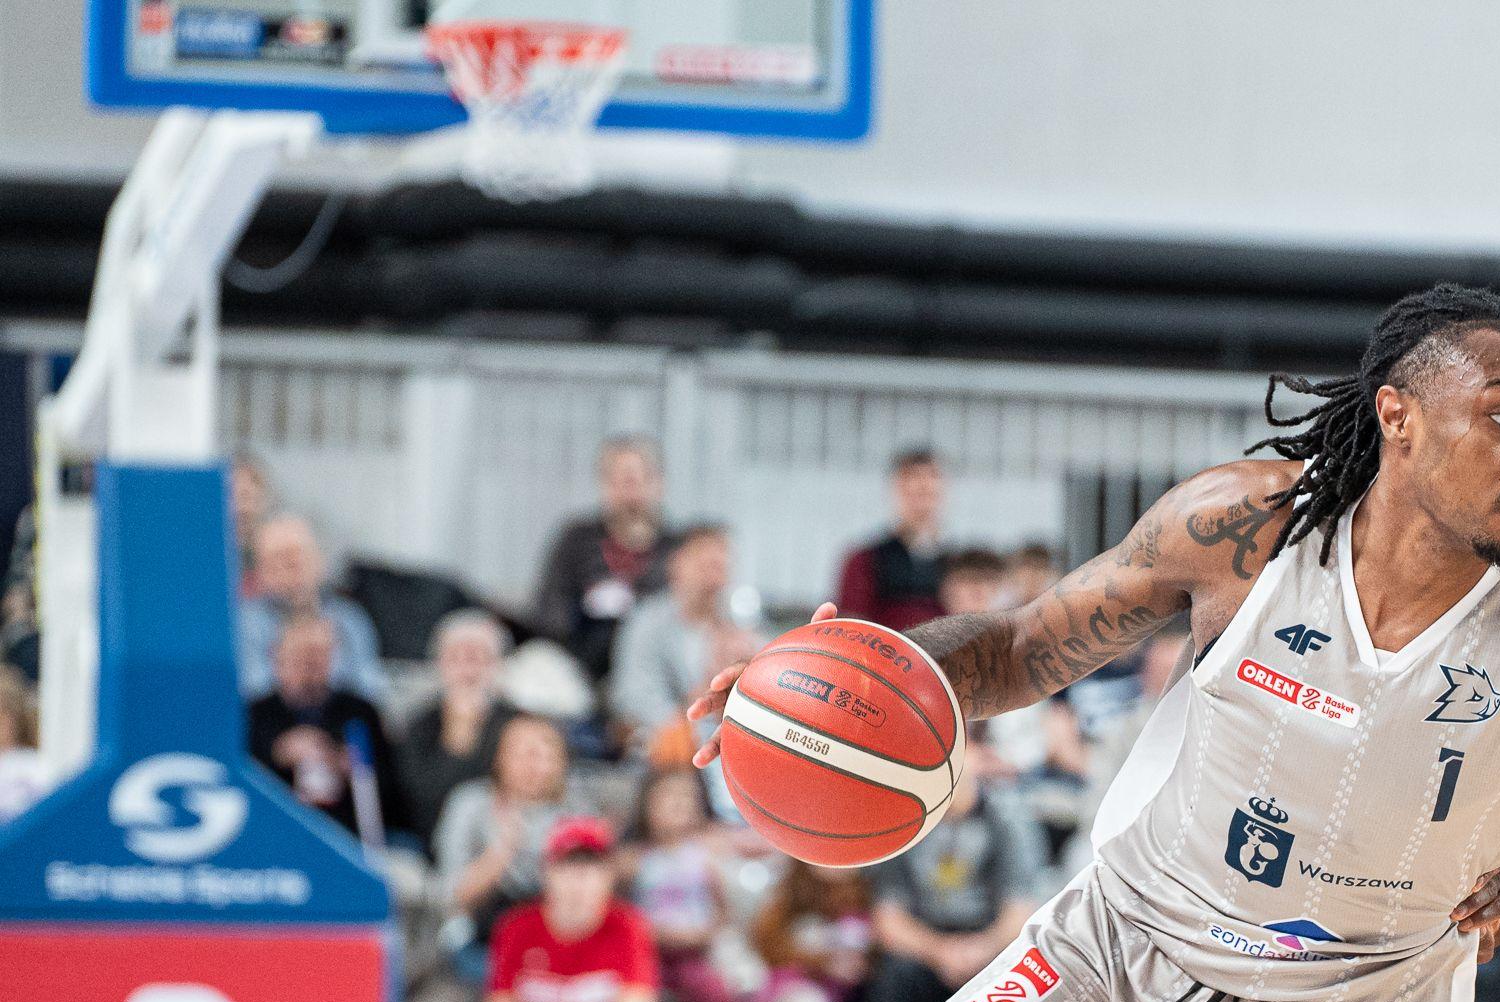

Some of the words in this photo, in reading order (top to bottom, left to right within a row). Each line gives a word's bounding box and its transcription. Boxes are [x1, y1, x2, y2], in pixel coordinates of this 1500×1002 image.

[815, 627, 912, 673] molten
[1274, 624, 1331, 656] 4F
[781, 674, 828, 697] ORLEN
[1243, 665, 1296, 698] ORLEN
[851, 705, 867, 718] Liga
[854, 698, 880, 717] Basket
[1321, 705, 1341, 719] Liga
[1324, 696, 1354, 714] Basket
[1431, 747, 1465, 822] 1
[1299, 861, 1413, 890] Warszawa
[1023, 956, 1055, 987] ORLEN
